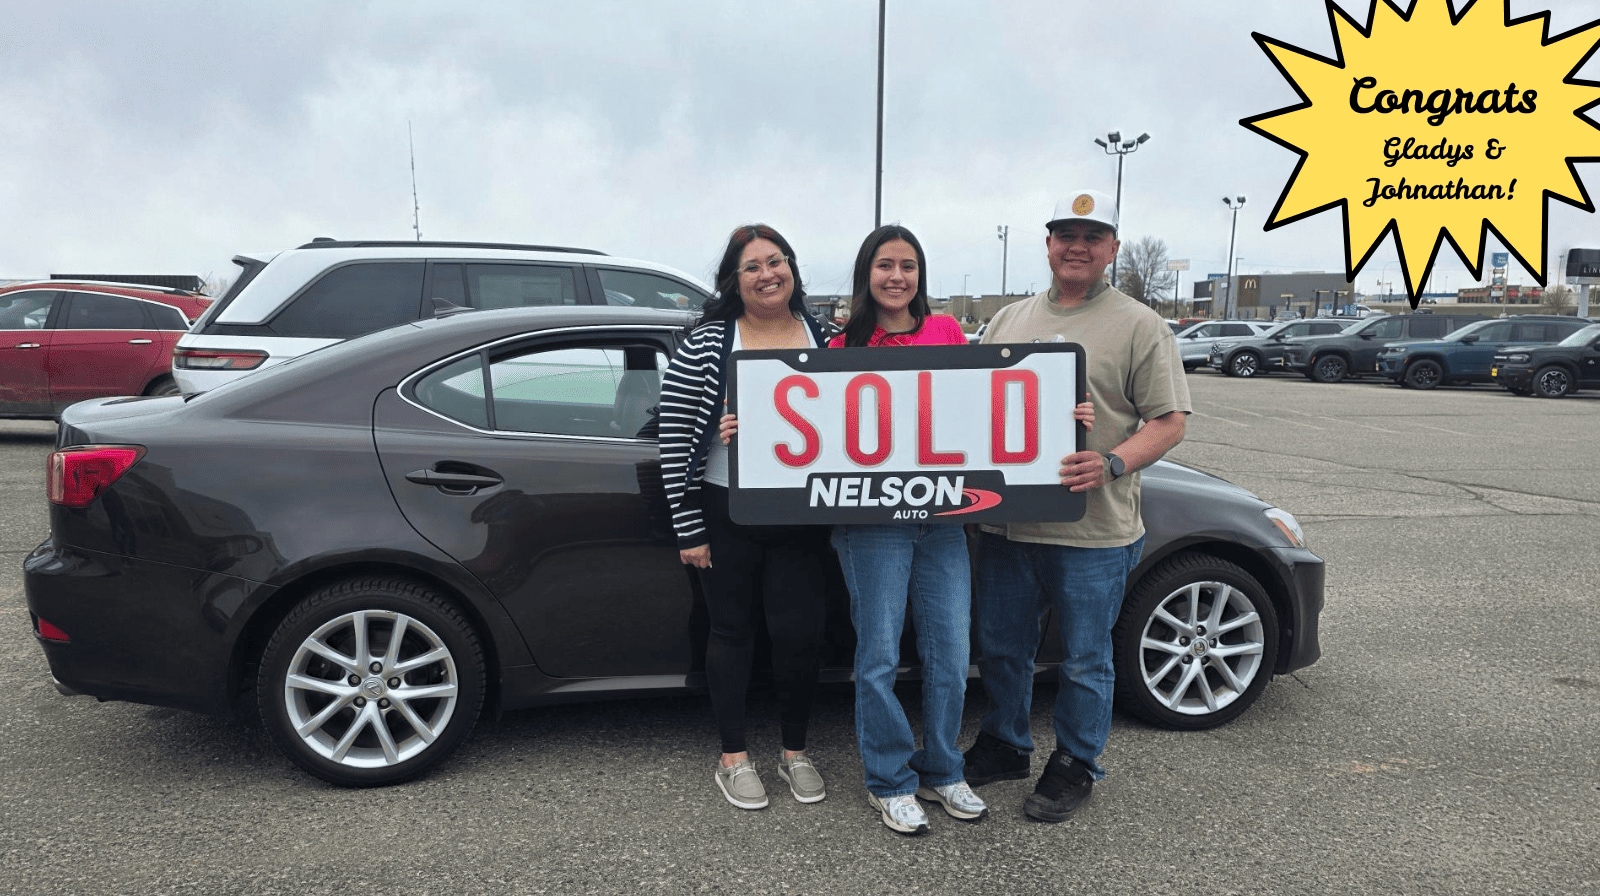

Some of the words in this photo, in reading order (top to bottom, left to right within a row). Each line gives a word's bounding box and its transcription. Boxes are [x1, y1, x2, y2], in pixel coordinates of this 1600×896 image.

[1583, 266, 1600, 274] LIN
[772, 369, 1040, 468] SOLD
[809, 475, 964, 507] NELSON
[893, 510, 928, 520] AUTO
